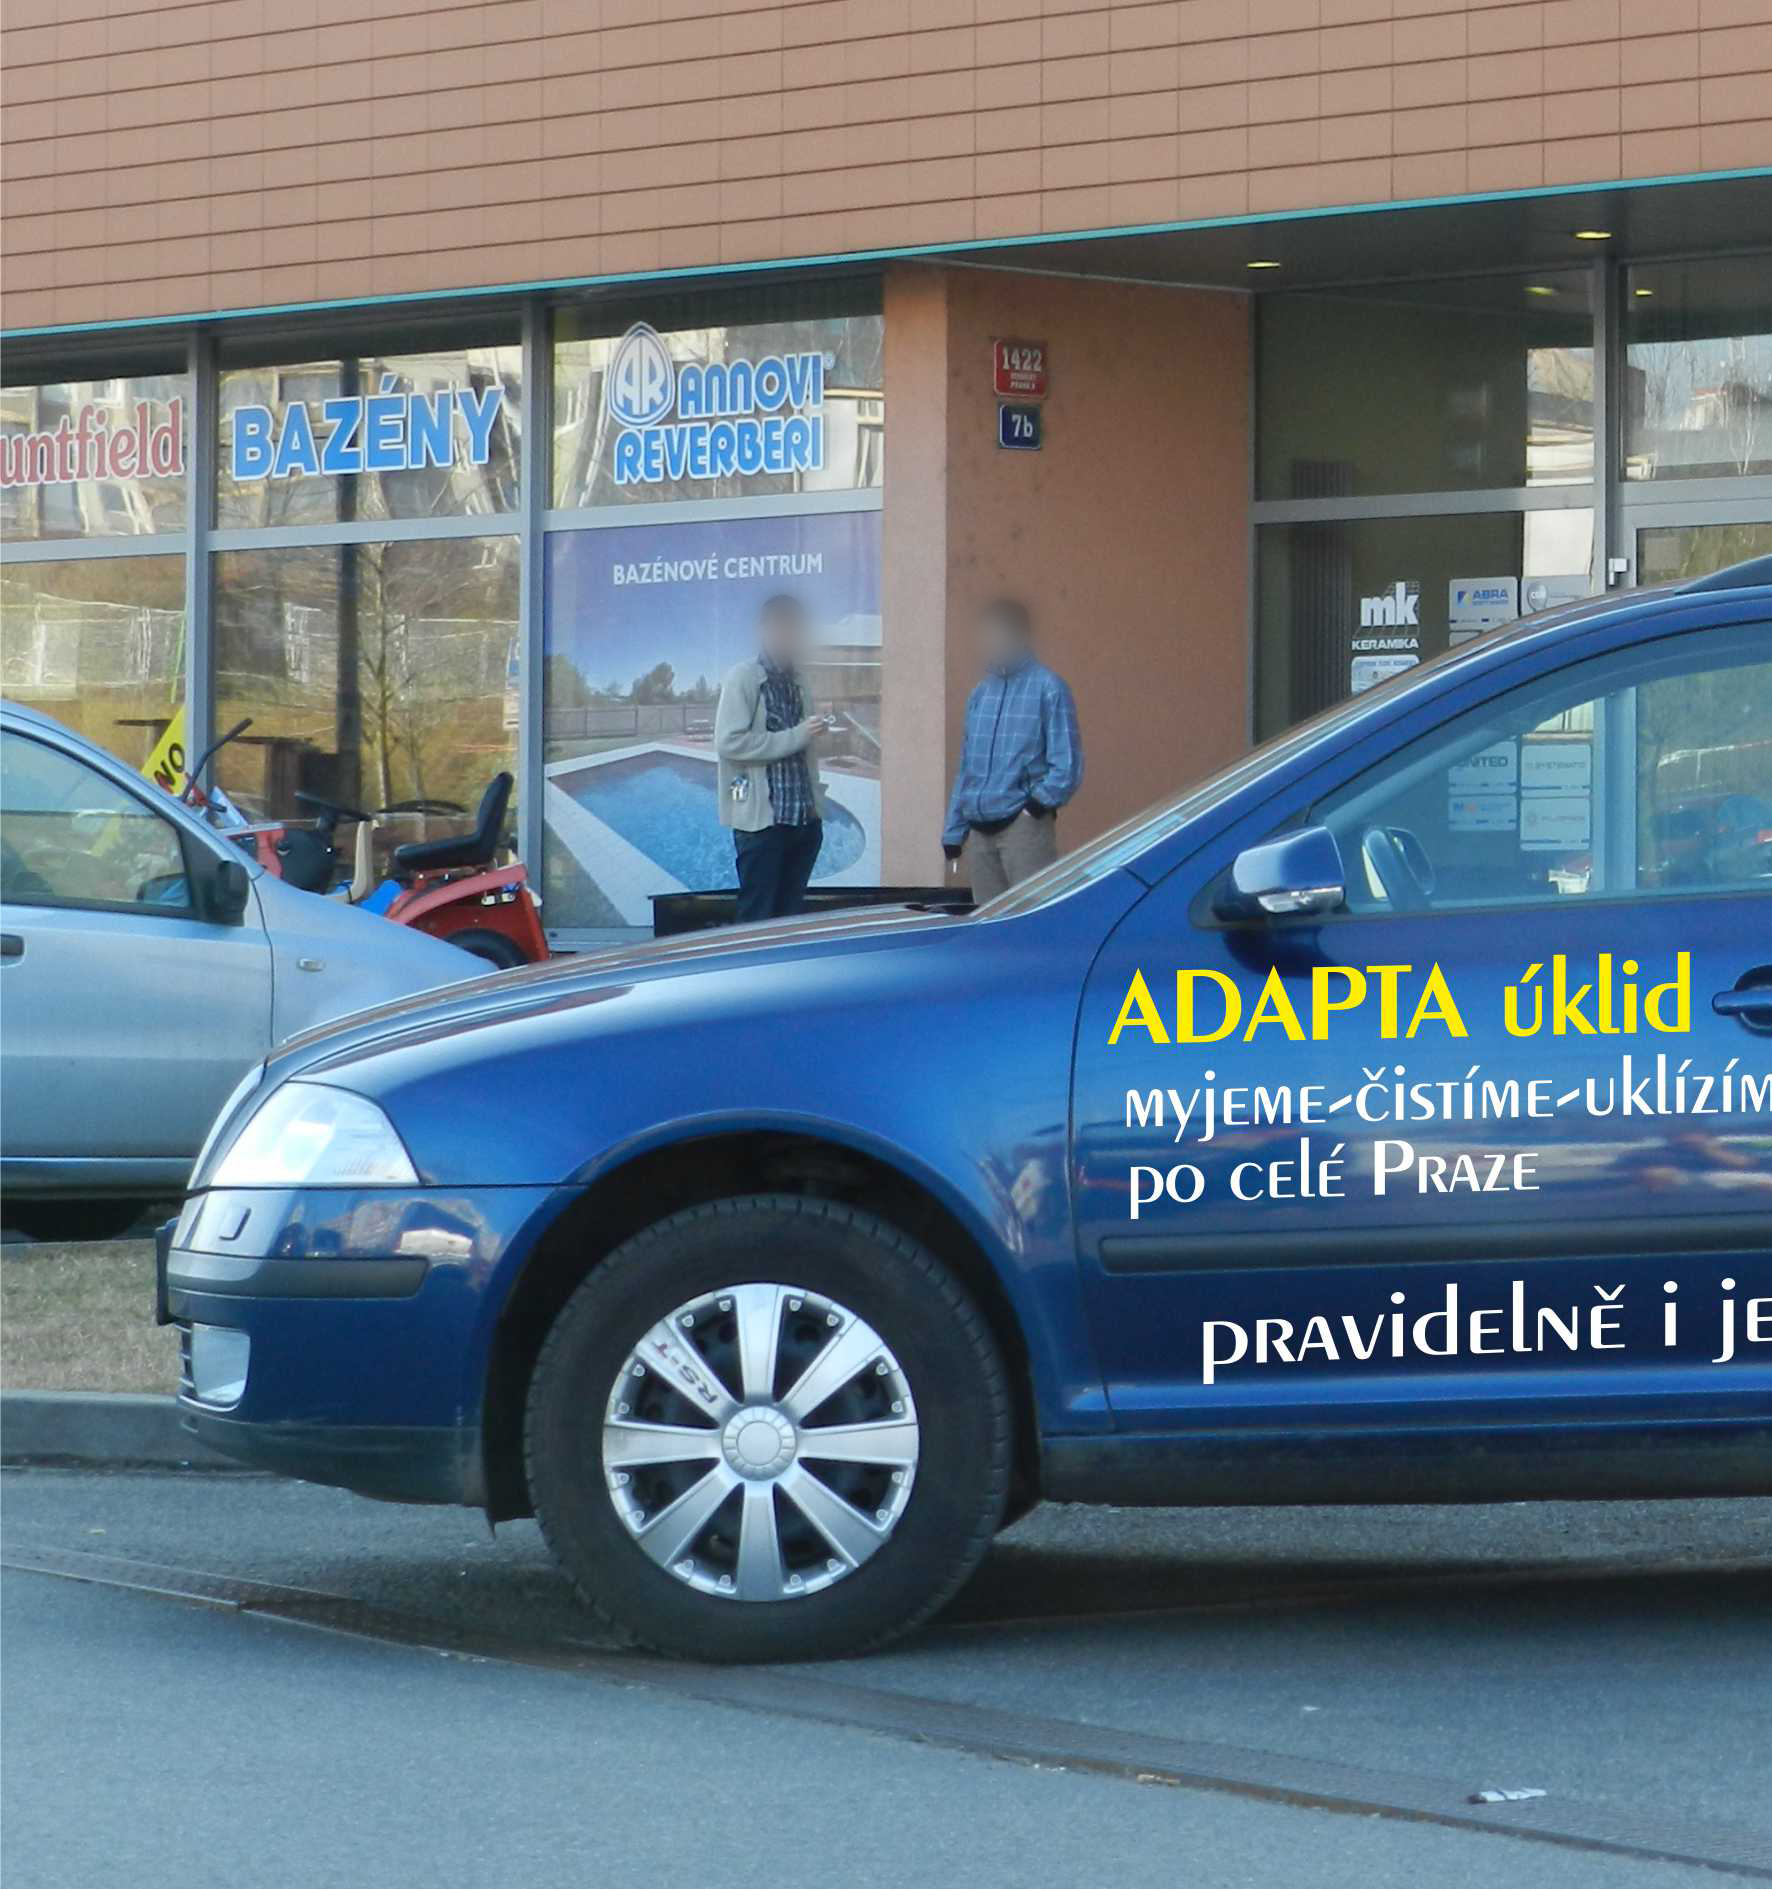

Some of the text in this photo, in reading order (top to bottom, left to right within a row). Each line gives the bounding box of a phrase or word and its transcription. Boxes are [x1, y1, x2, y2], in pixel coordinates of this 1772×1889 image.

[678, 352, 824, 419] ANNOVI
[1002, 347, 1042, 372] 1422
[232, 373, 505, 481] BAZÉNY
[614, 416, 824, 485] REVERBERI
[1011, 414, 1033, 438] 7b
[613, 553, 823, 585] BAZÉNOVÉ CENTRUM
[1361, 581, 1419, 626] mk
[1352, 638, 1419, 651] KERAMIKA
[1107, 951, 1692, 1045] ADAPTA úklid
[1130, 1137, 1541, 1220] po celé Praze
[1203, 1280, 1625, 1385] pravidelně
[1663, 1279, 1679, 1347] i
